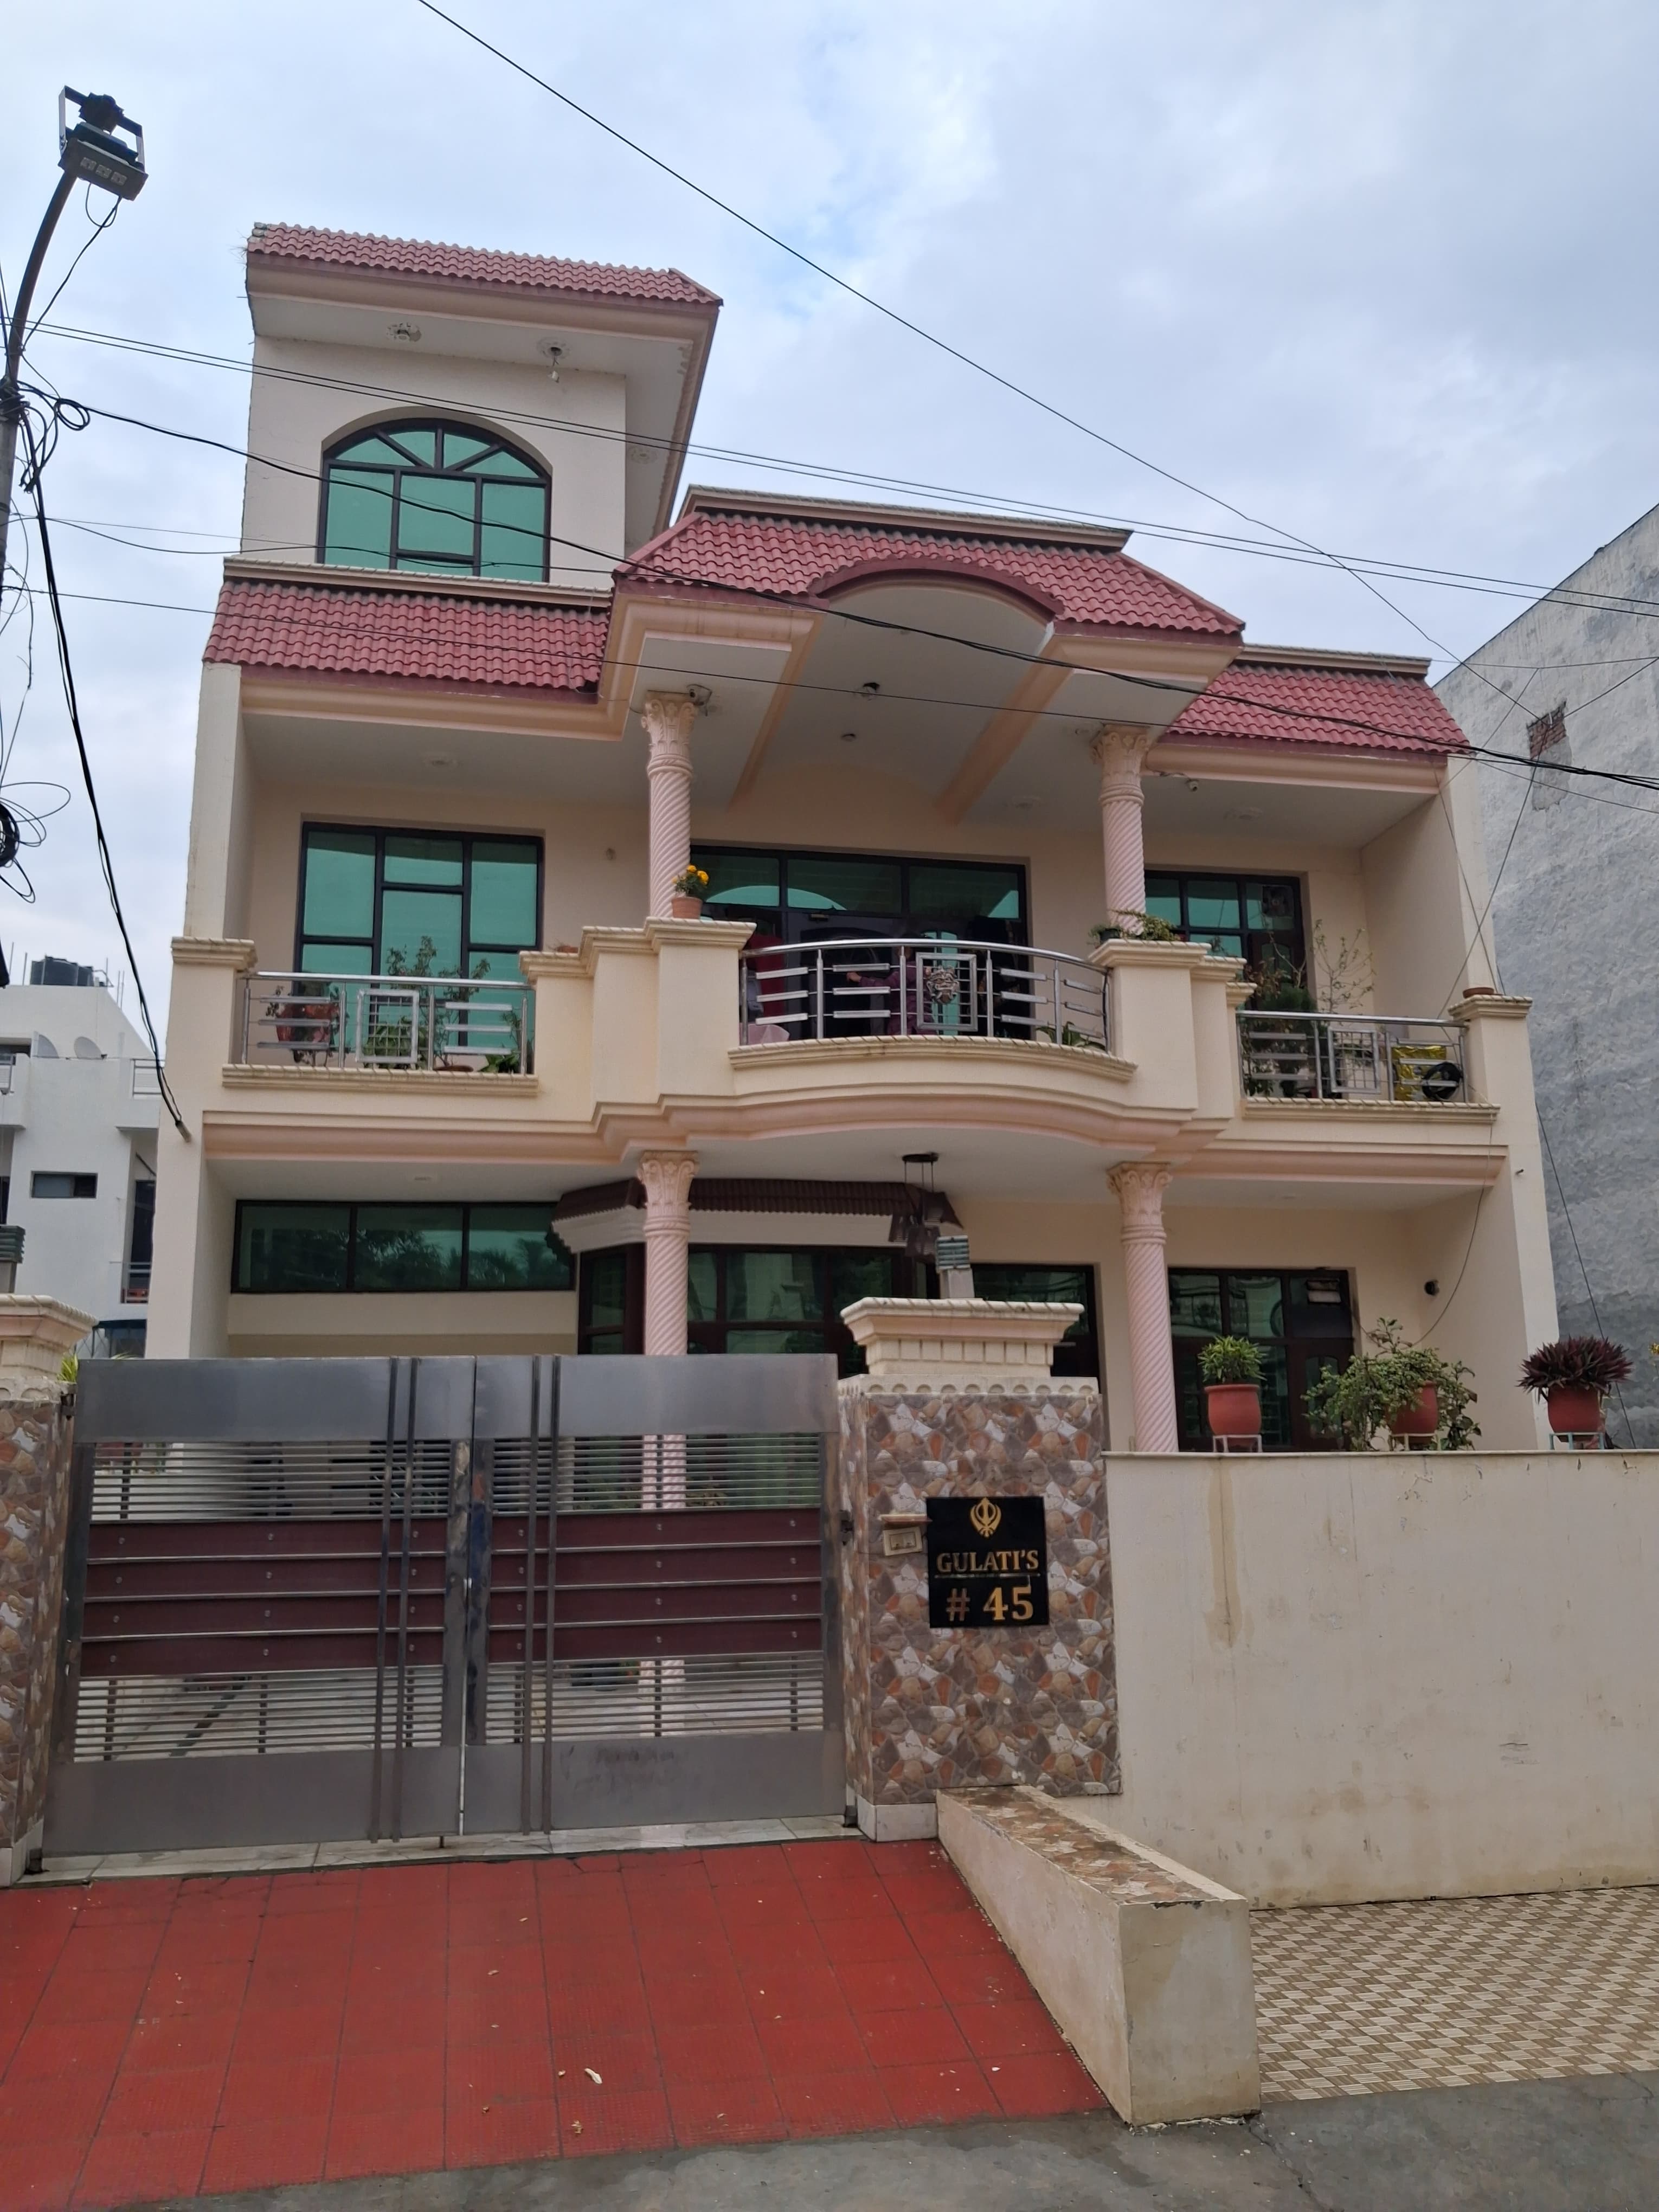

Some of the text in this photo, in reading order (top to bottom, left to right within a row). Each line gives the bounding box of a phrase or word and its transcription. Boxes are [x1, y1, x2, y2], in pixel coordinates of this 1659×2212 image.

[937, 1549, 1039, 1572] GULATI'S
[946, 1585, 1033, 1622] # 45
